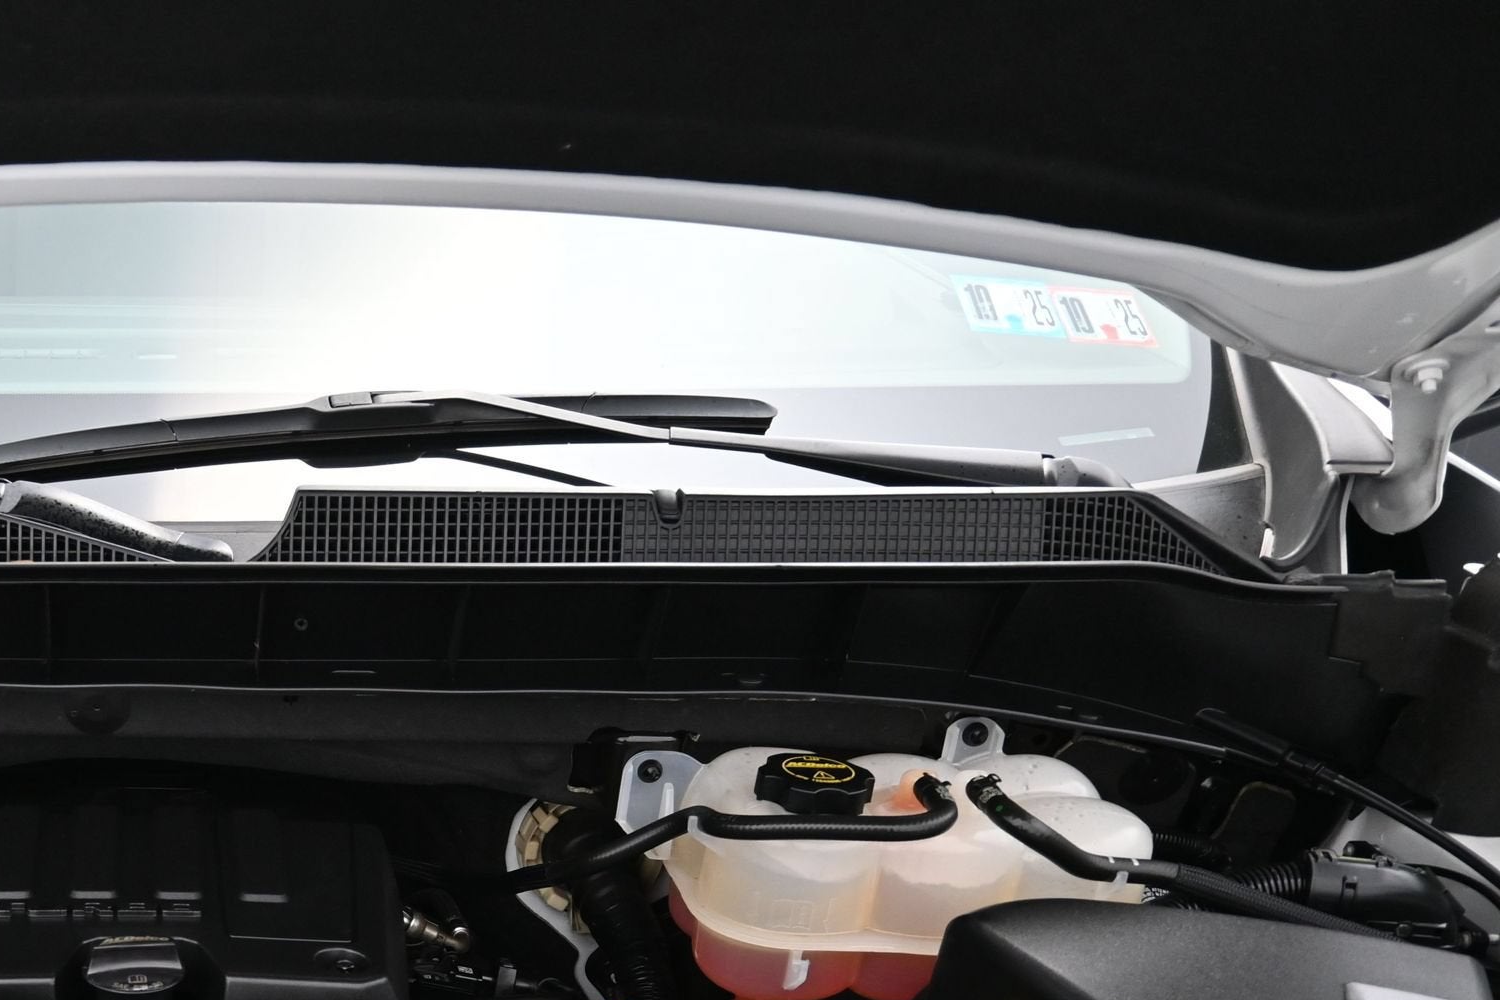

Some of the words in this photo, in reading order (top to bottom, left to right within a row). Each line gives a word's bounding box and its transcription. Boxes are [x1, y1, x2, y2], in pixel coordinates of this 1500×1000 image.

[1023, 289, 1055, 327] 25
[1114, 298, 1148, 336] 25
[100, 935, 170, 946] ACDelco
